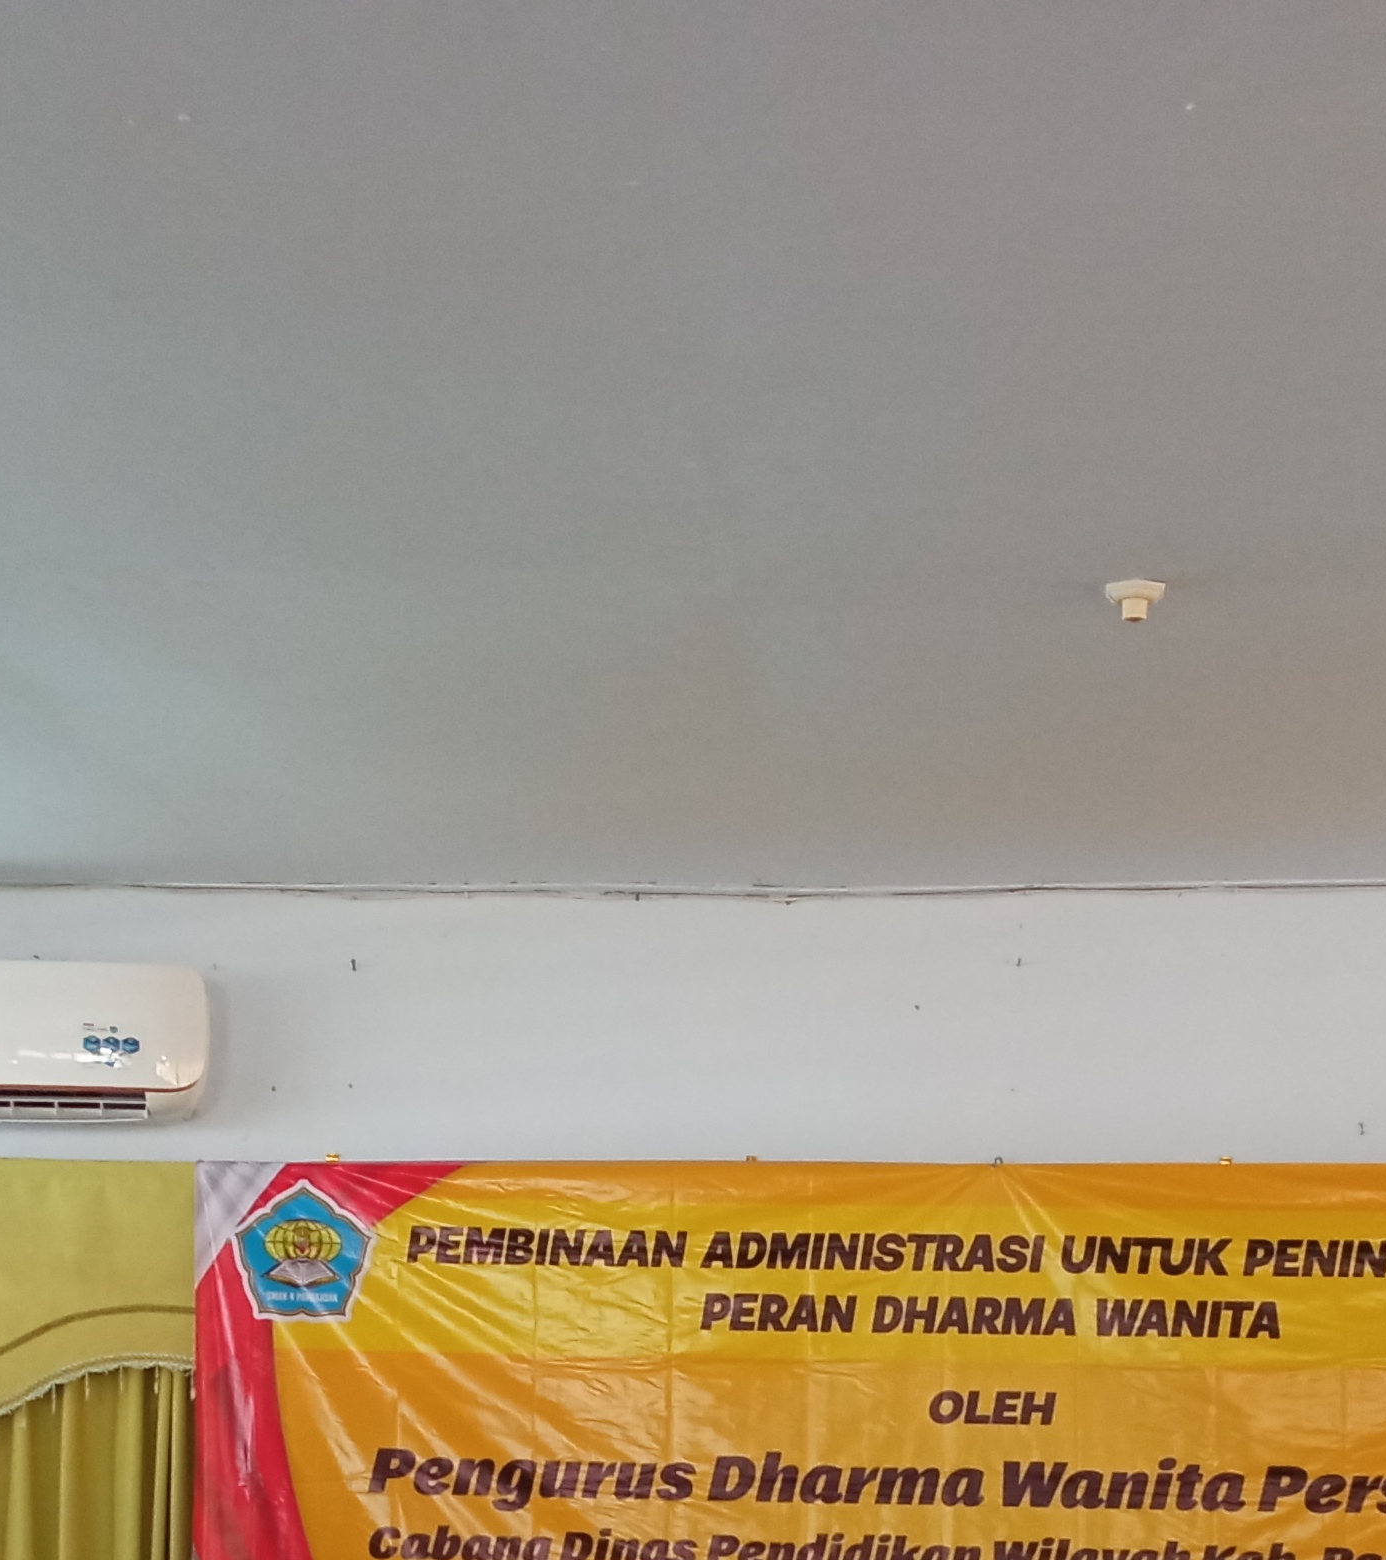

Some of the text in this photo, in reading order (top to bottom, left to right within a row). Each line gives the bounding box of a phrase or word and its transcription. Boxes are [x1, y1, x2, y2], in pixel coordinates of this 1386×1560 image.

[408, 1227, 687, 1267] PEMBINAAN
[701, 1232, 1044, 1272] ADMINISTRASI
[1062, 1236, 1232, 1275] UNTUK
[701, 1294, 1279, 1338] PERAN DHARMA WANITA
[930, 1391, 1056, 1425] OLEH
[371, 1449, 695, 1511] Pengurus
[708, 1452, 983, 1506] Dharma
[1003, 1458, 1245, 1511] Wanita
